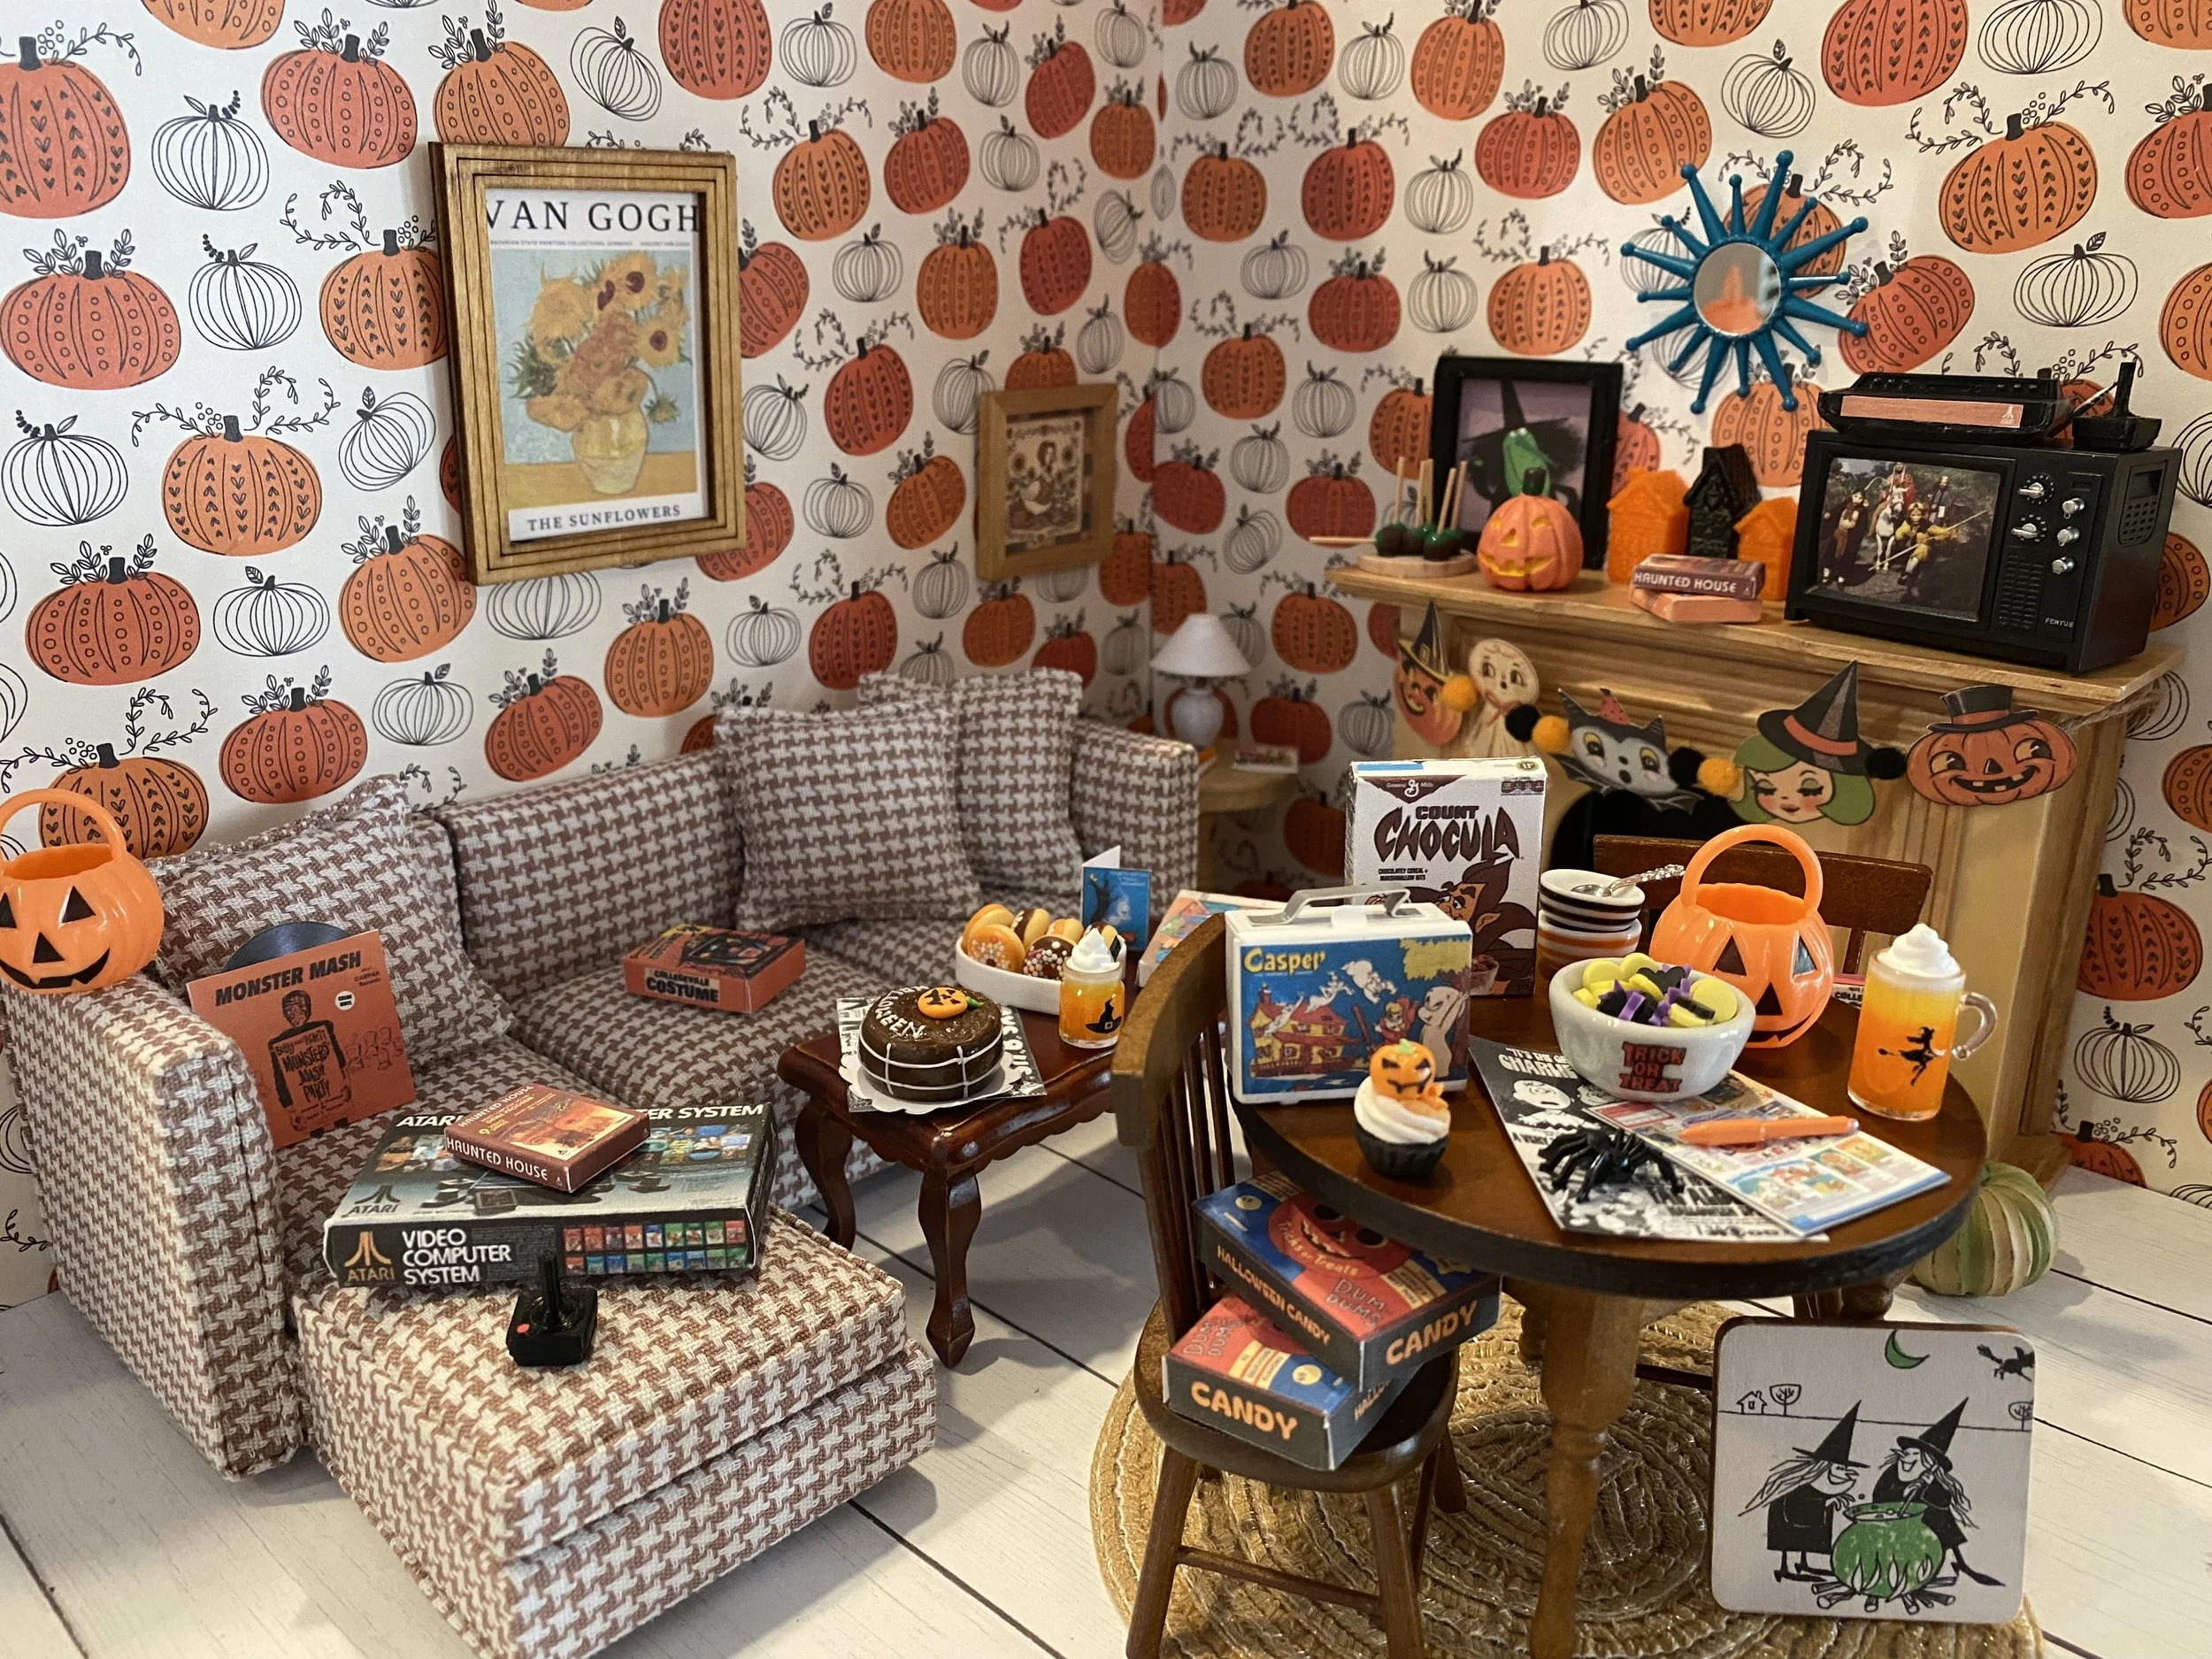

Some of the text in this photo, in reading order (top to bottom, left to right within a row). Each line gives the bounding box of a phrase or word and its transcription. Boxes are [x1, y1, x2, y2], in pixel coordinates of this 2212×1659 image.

[486, 200, 698, 232] VAN GOGH
[527, 504, 680, 531] THE SUNFLOWERS
[1634, 572, 1738, 594] HAUNTED HOUSE
[2045, 618, 2075, 628] FENYUE
[1416, 805, 1479, 819] COUNT
[1374, 806, 1520, 863] CHOCULA
[1243, 947, 1325, 975] Casper
[215, 950, 362, 1006] MONSTER MASH
[647, 977, 719, 1002] COSTUME
[1498, 1054, 1578, 1079] CHARLIE
[1622, 1041, 1687, 1068] TRICK
[1633, 1062, 1662, 1078] OR
[303, 1079, 330, 1102] PARTY
[1619, 1073, 1682, 1094] TREAT
[458, 1102, 502, 1127] HAUNTED
[502, 1086, 534, 1103] HOUSE
[677, 1104, 764, 1118] SYSTEM
[447, 1136, 548, 1181] HAUNTED HOUSE
[347, 1203, 400, 1216] ATARI
[402, 1228, 466, 1248] VIDEO
[403, 1244, 512, 1267] COMPUTER
[1314, 1256, 1358, 1277] Treats
[347, 1268, 395, 1282] ATARI
[403, 1265, 480, 1285] SYSTEM
[1217, 1245, 1331, 1346] HALLOWEEN CANDY
[1334, 1278, 1386, 1310] DUM
[1325, 1294, 1382, 1328] DUMS
[1386, 1301, 1479, 1366] CANDY
[1190, 1381, 1298, 1441] CANDY
